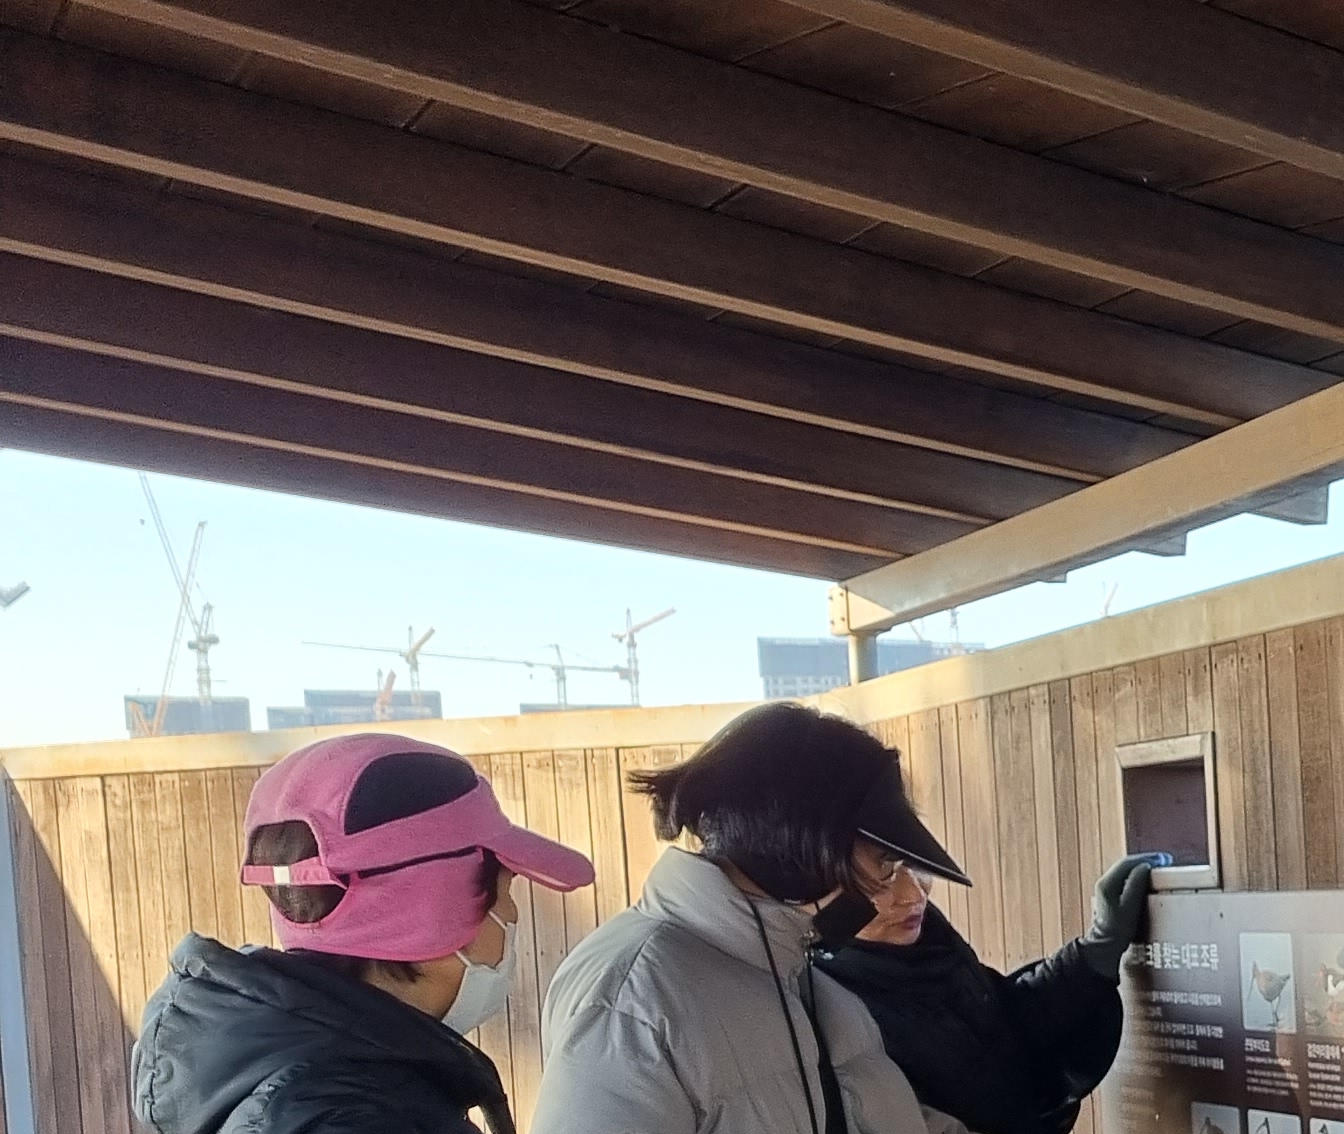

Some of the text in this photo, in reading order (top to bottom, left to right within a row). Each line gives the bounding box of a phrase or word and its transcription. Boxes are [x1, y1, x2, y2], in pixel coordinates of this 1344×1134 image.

[1131, 942, 1162, 969] 파크를
[1182, 942, 1200, 969] 대표
[1201, 942, 1220, 972] 조류
